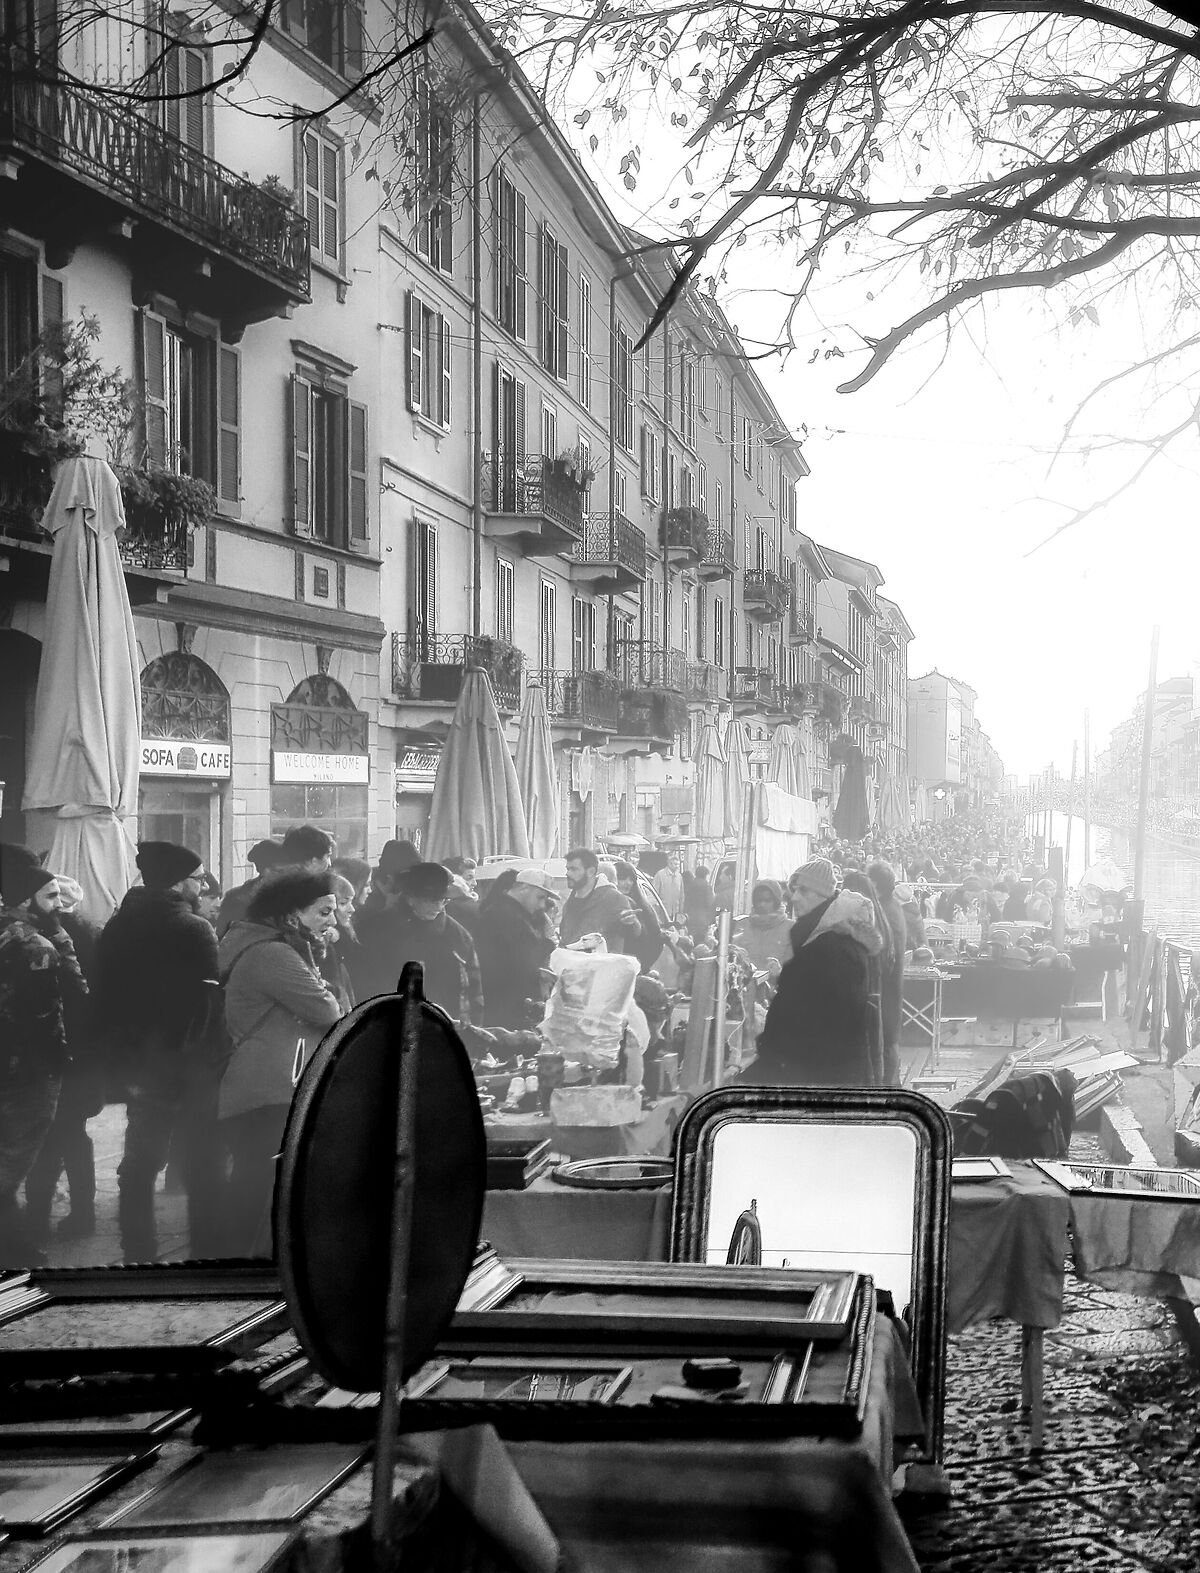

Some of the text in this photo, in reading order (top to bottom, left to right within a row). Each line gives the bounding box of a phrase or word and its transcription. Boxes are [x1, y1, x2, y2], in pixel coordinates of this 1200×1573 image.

[142, 748, 229, 769] SOFA CAFE
[283, 754, 360, 770] WELCOME HOME
[313, 773, 334, 781] MILANO
